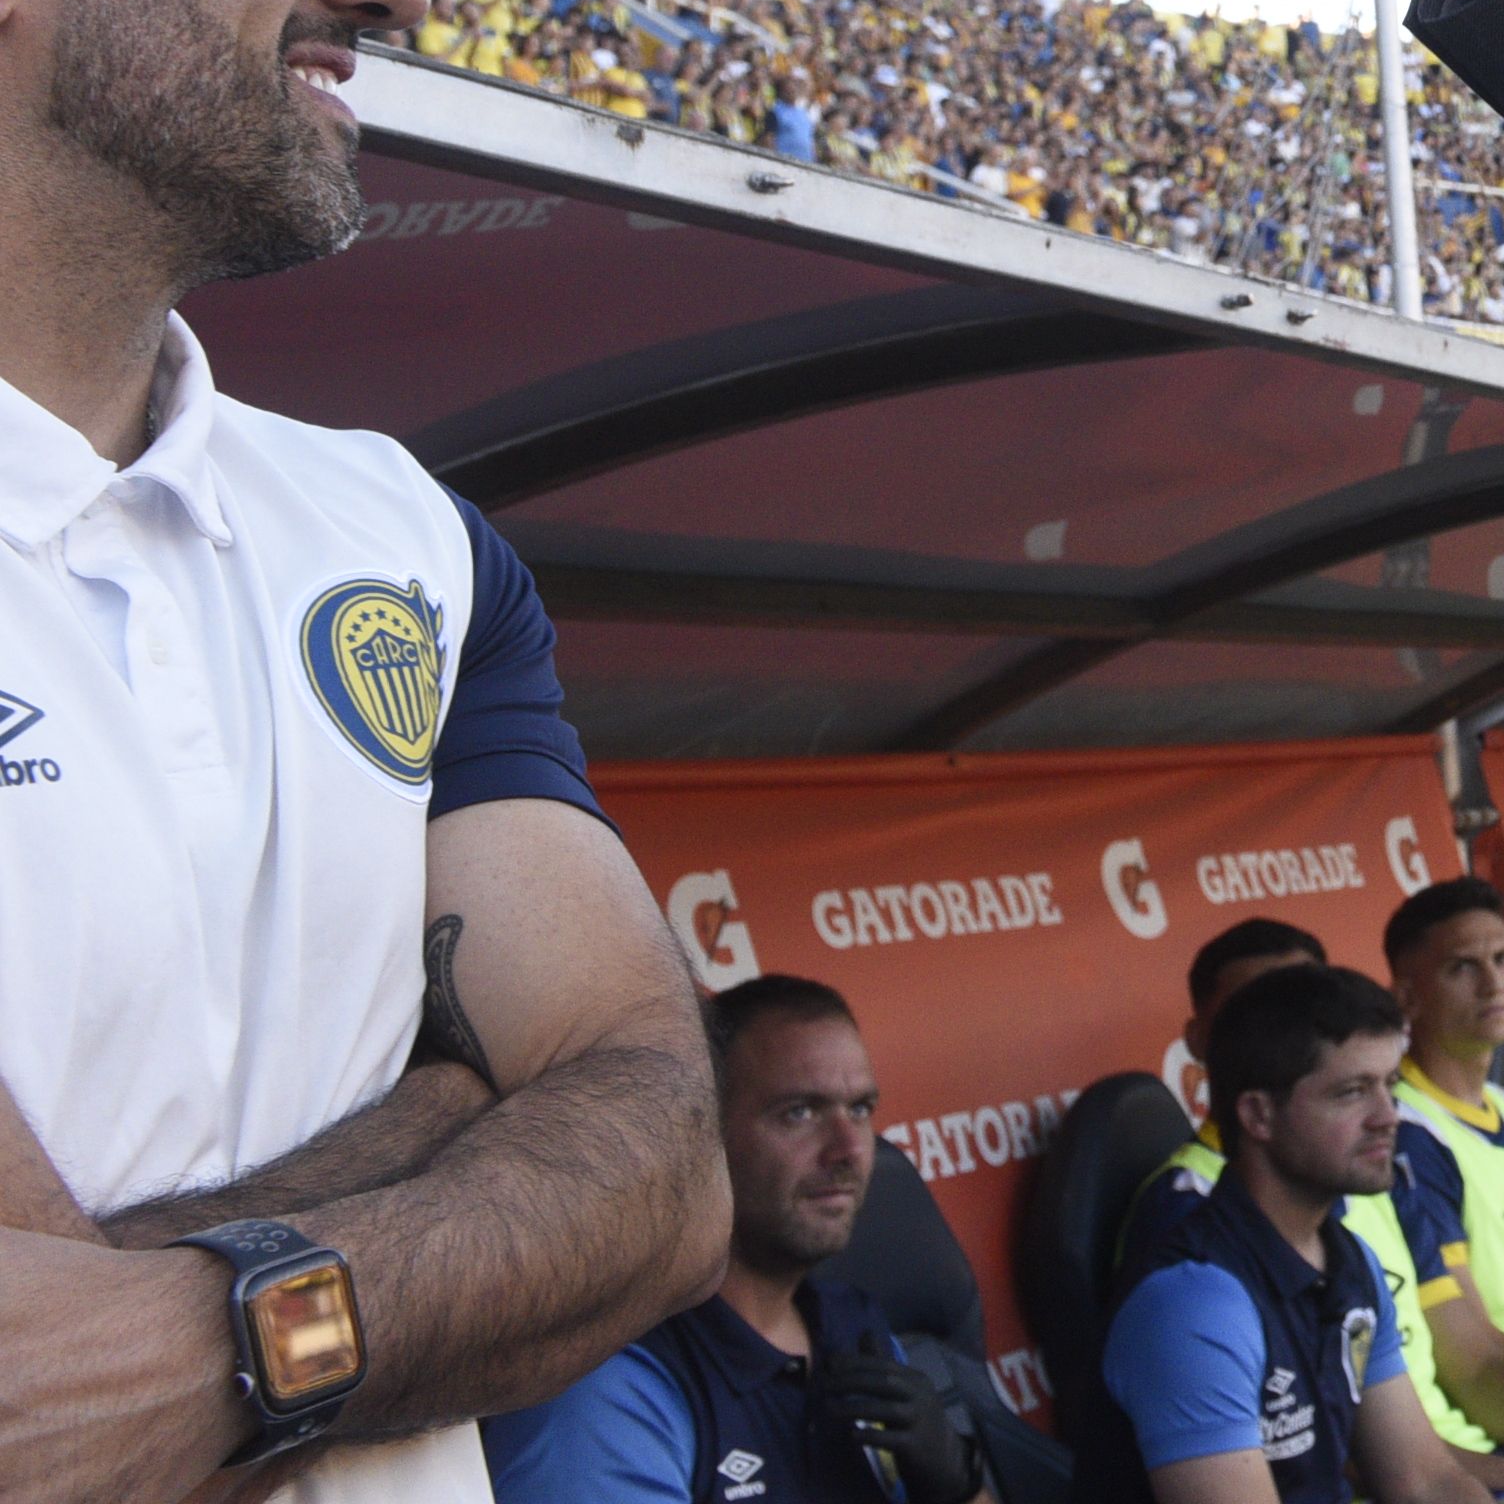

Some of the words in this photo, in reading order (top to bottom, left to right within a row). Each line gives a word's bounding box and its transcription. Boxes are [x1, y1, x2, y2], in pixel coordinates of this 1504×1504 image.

[355, 634, 419, 668] CARC
[0, 754, 62, 787] bro
[812, 872, 1064, 951] GATORADE
[1101, 837, 1169, 940] G
[1196, 842, 1366, 905] GATORADE
[1384, 815, 1432, 897] G
